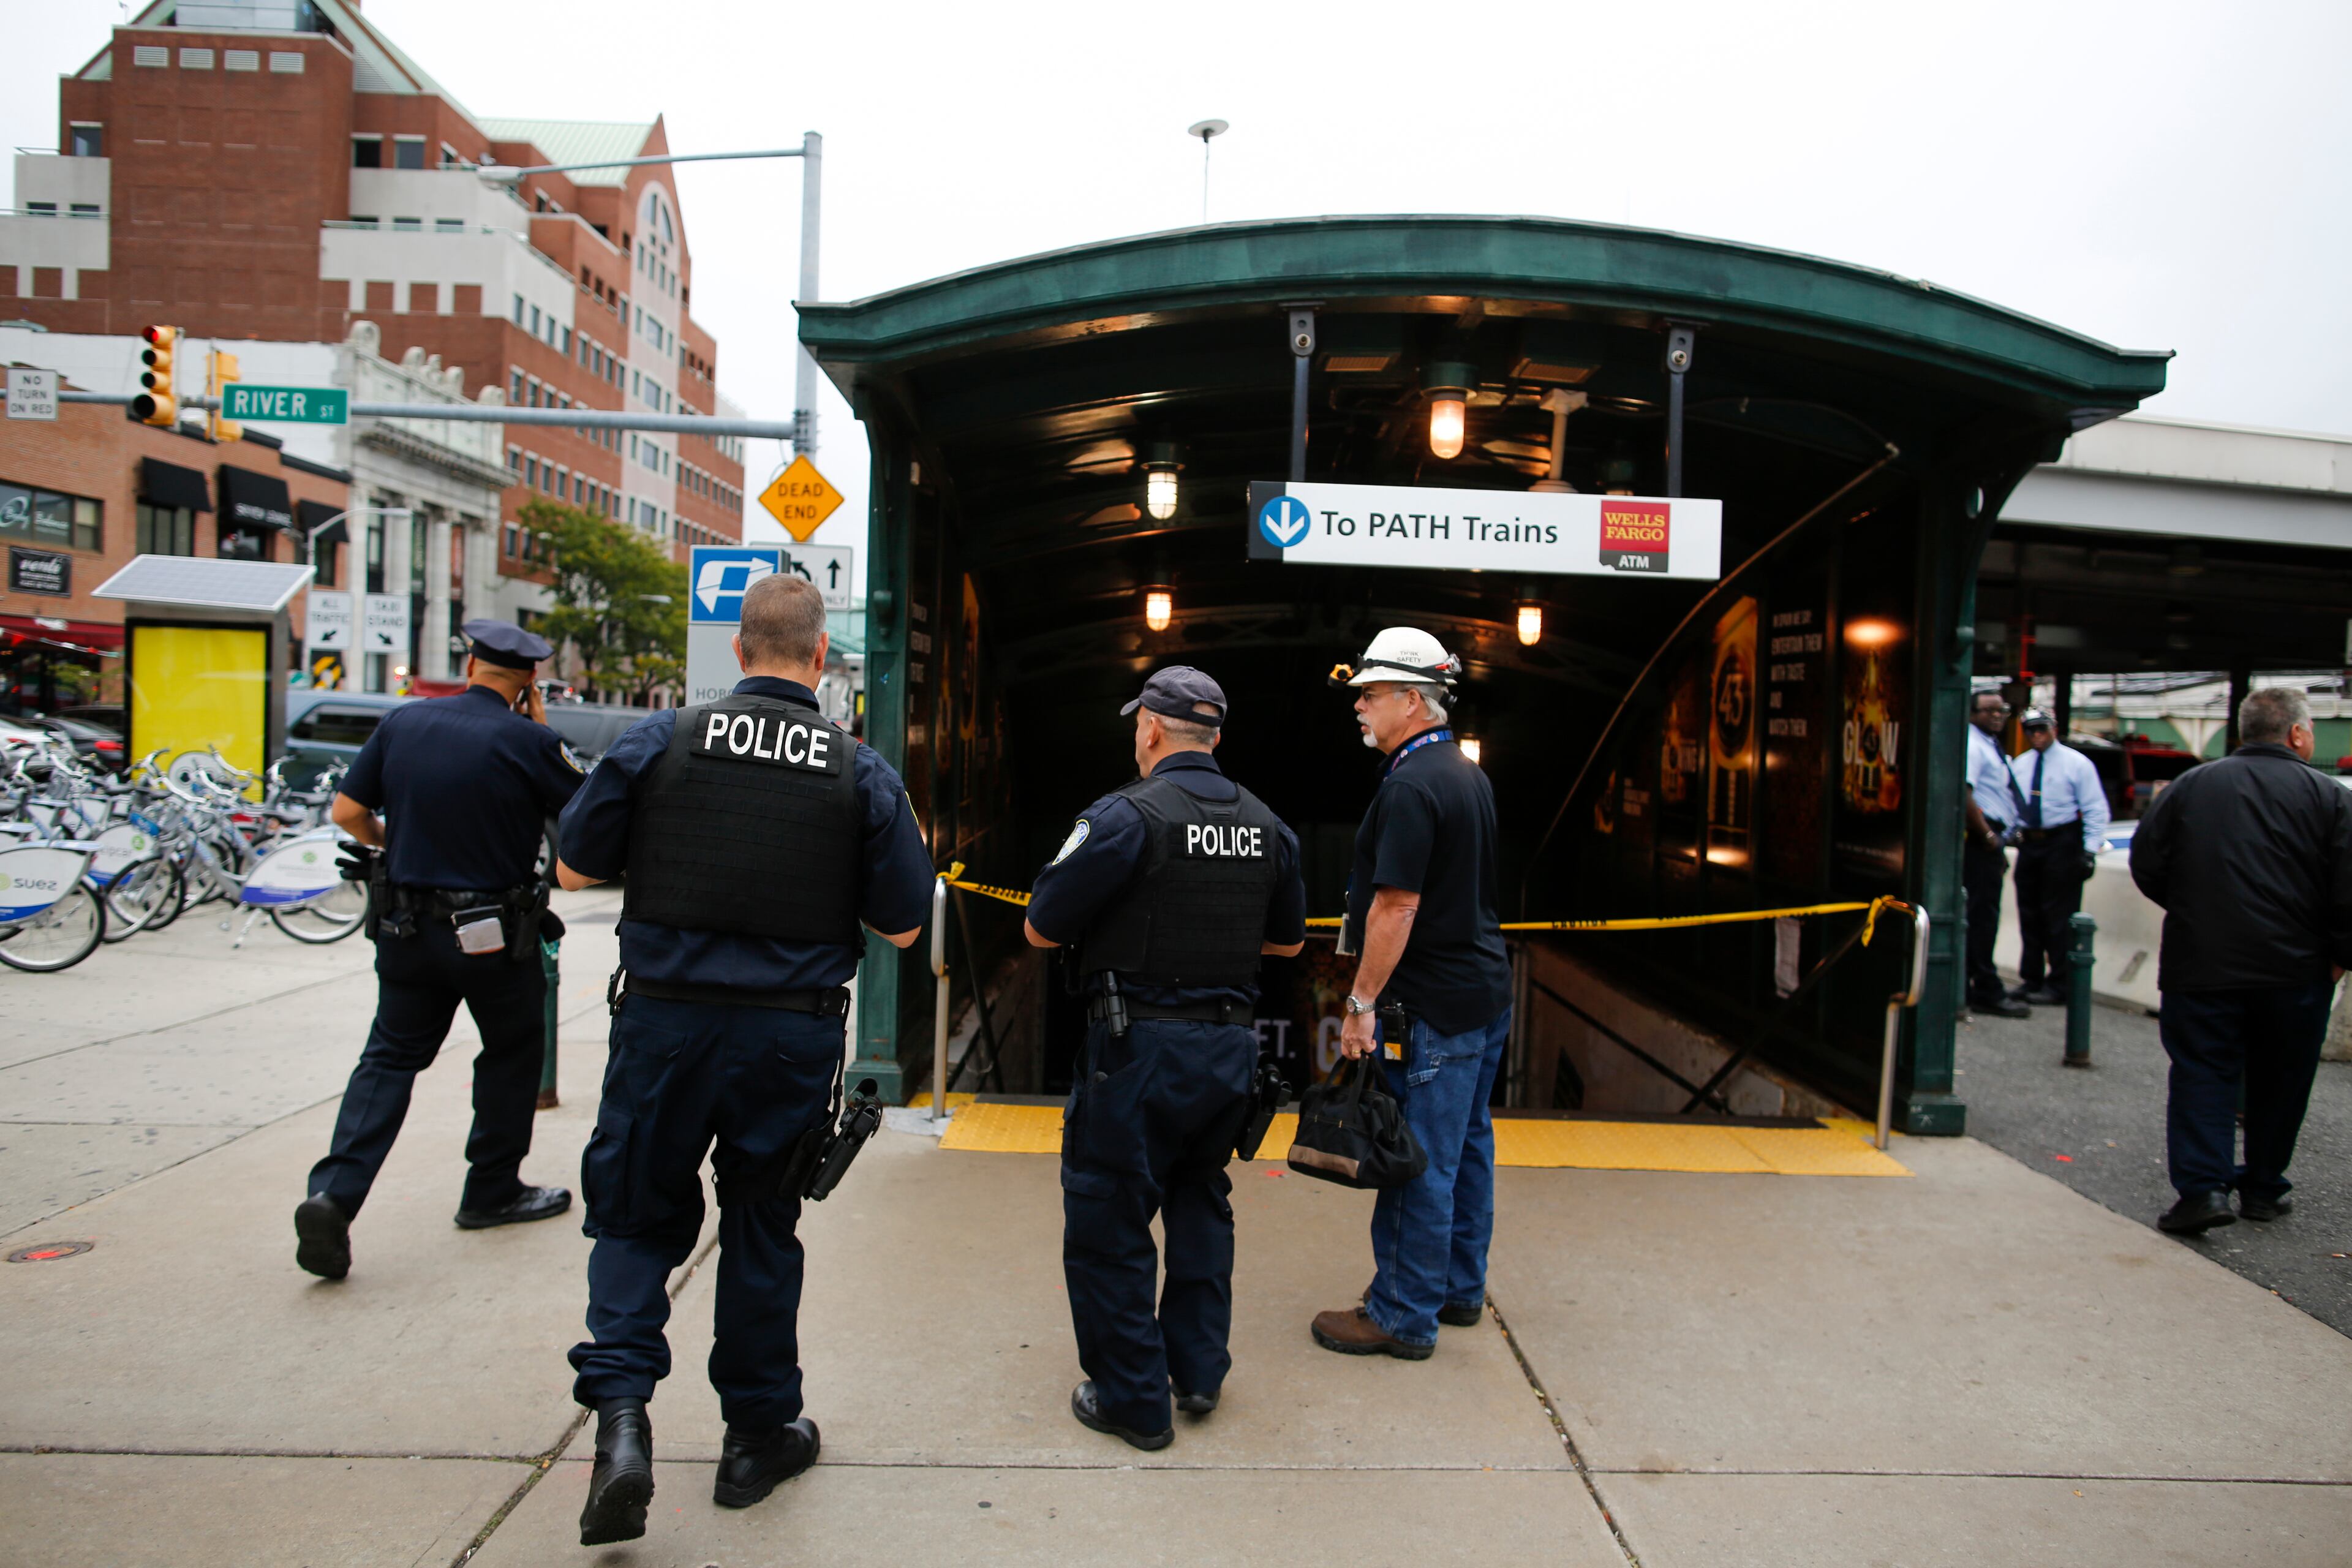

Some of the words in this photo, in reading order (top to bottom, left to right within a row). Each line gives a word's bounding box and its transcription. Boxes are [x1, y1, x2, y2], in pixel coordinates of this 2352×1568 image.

[23, 375, 41, 385] NO
[17, 388, 47, 400] TURN
[10, 402, 26, 413] ON
[31, 403, 52, 414] RED
[234, 390, 306, 417] RIVER
[320, 404, 335, 419] ST
[778, 483, 823, 497] DEAD
[784, 505, 817, 519] END
[1604, 512, 1665, 527] WELLS
[1321, 510, 1355, 537] To
[1369, 512, 1450, 540] PATH
[1463, 516, 1558, 544] Trains
[1605, 526, 1665, 541] FARGO
[1618, 554, 1649, 569] ATM
[322, 598, 340, 608] ALL
[374, 600, 401, 611] TAXI
[823, 595, 846, 605] NLY
[311, 613, 350, 625] TRAFFIC
[368, 614, 407, 627] STAND
[1719, 673, 1744, 726] 43
[704, 713, 831, 768] POLICE
[1187, 824, 1262, 857] POLICE
[14, 878, 58, 892] suez
